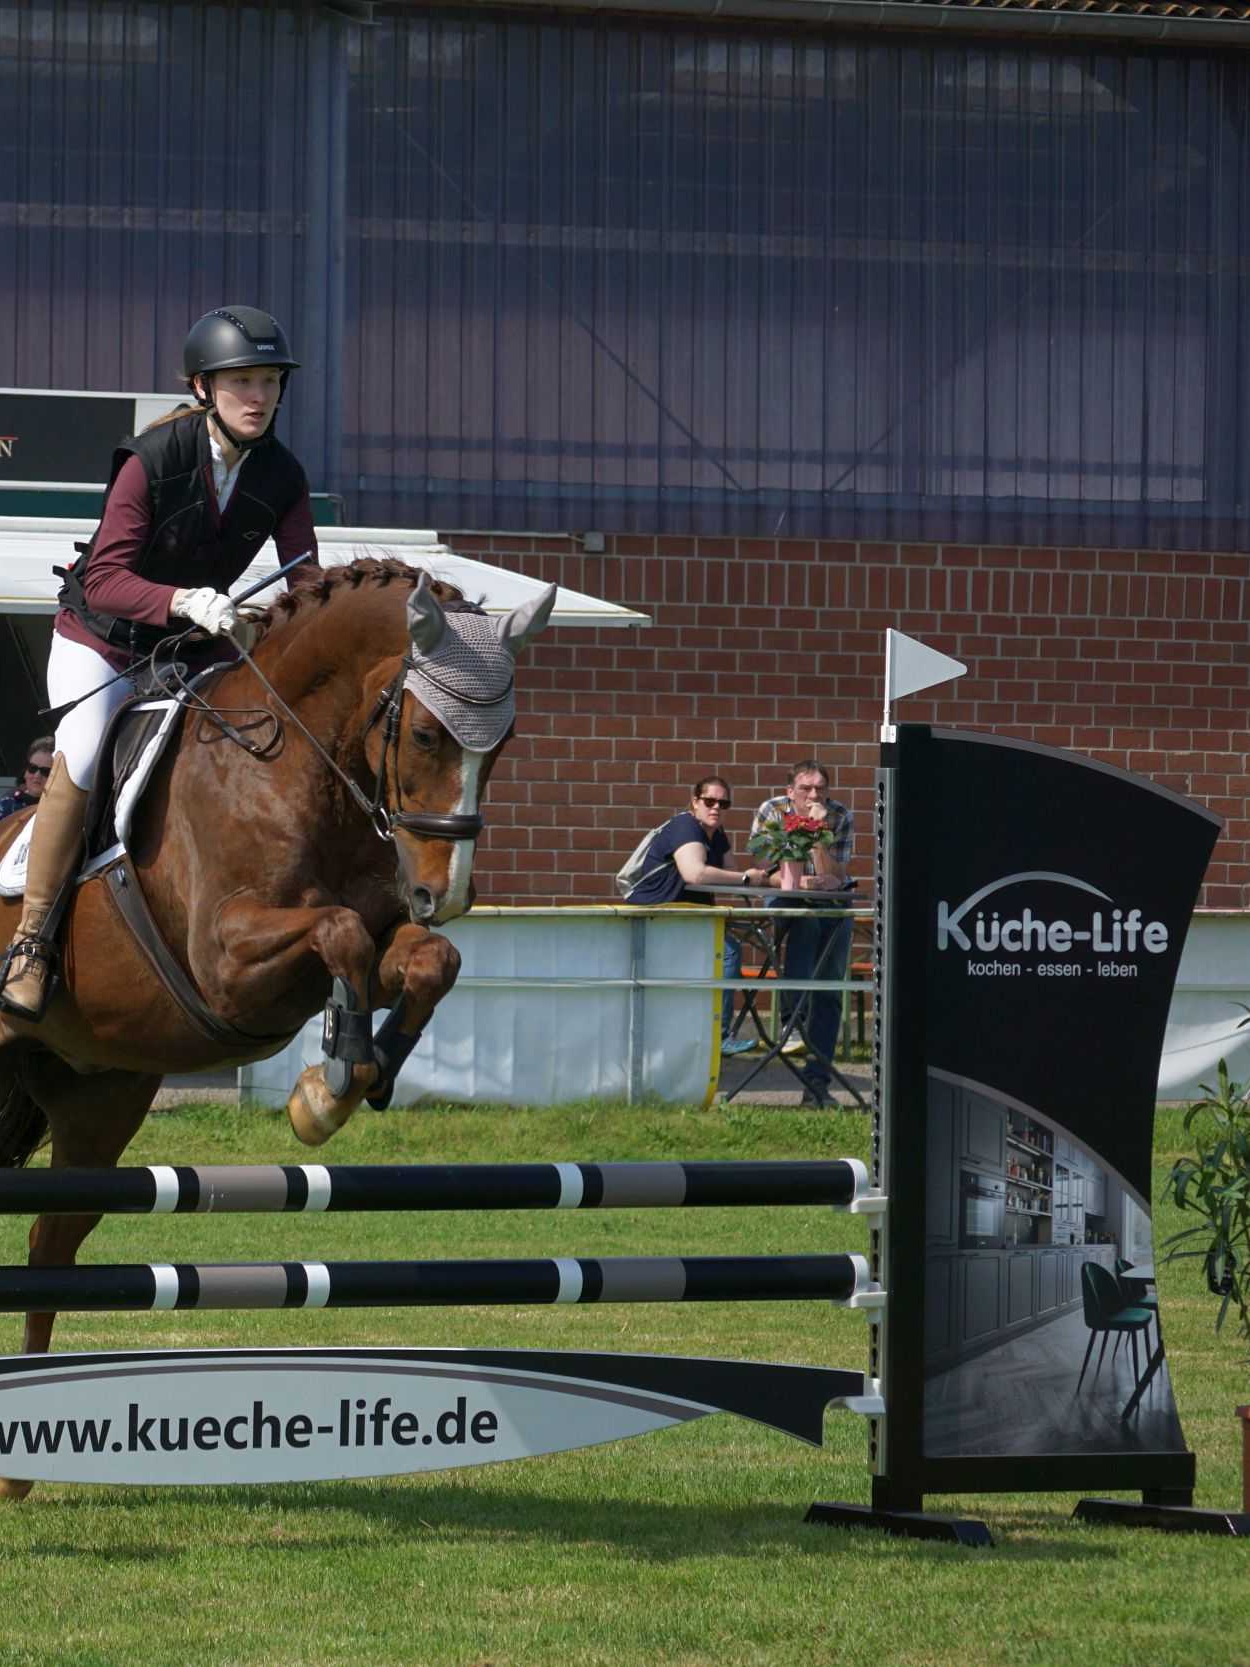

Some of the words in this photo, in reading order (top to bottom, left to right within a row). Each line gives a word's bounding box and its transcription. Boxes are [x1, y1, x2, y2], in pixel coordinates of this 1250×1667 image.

[937, 900, 1169, 953] Küche-Life
[967, 960, 1021, 976] kochen
[1037, 964, 1081, 976] essen
[1097, 961, 1138, 977] leben
